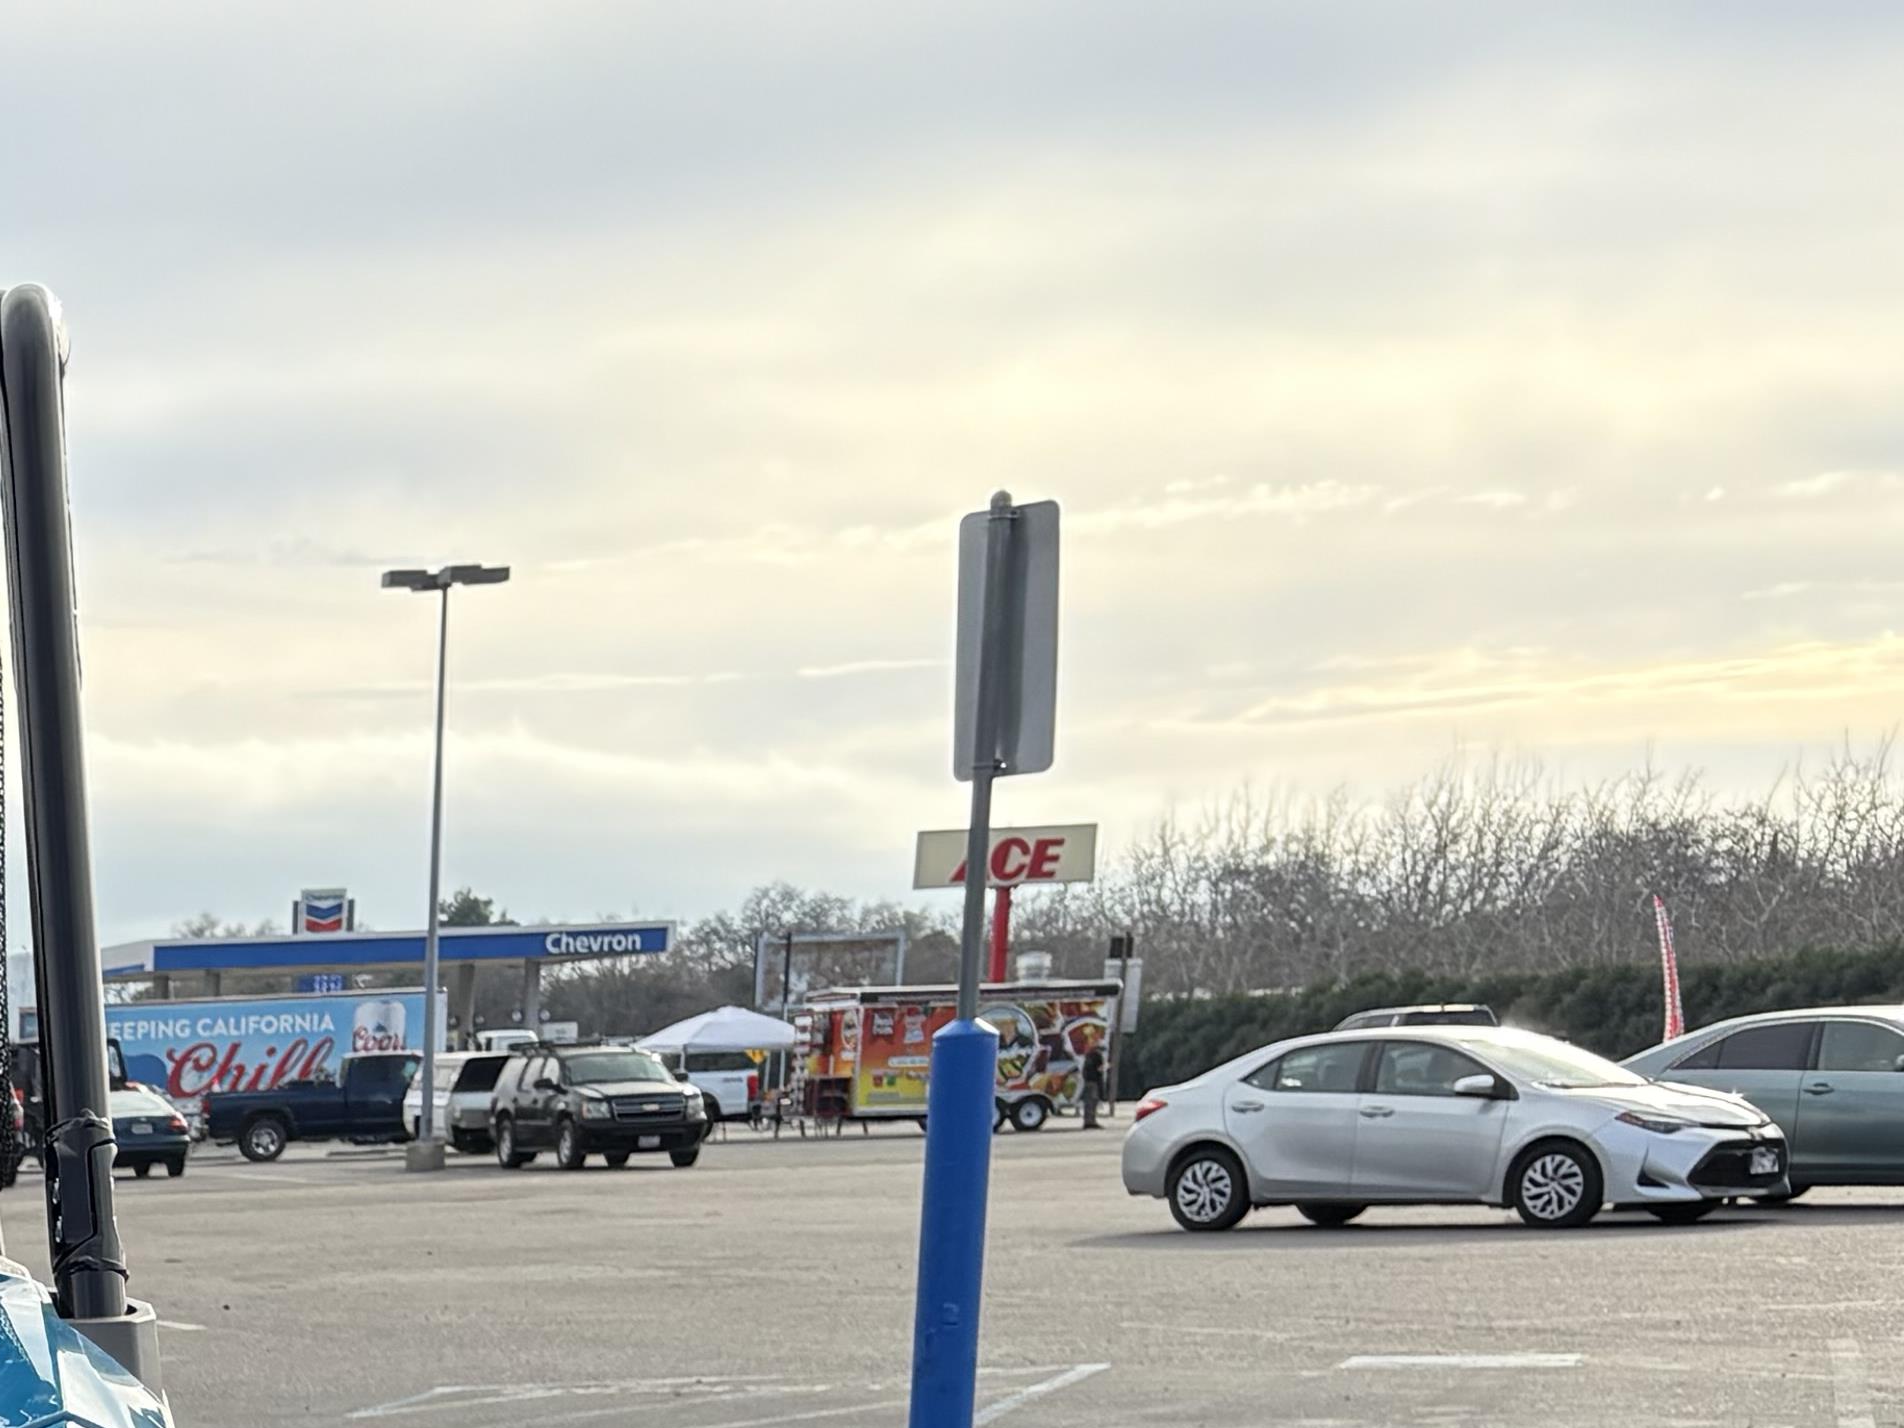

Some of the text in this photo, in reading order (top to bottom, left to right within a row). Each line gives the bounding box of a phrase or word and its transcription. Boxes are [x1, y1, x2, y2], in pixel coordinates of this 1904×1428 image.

[545, 931, 642, 954] Chevron
[107, 1012, 335, 1041] EEPING CALIFORNIA
[166, 1035, 335, 1099] Chill
